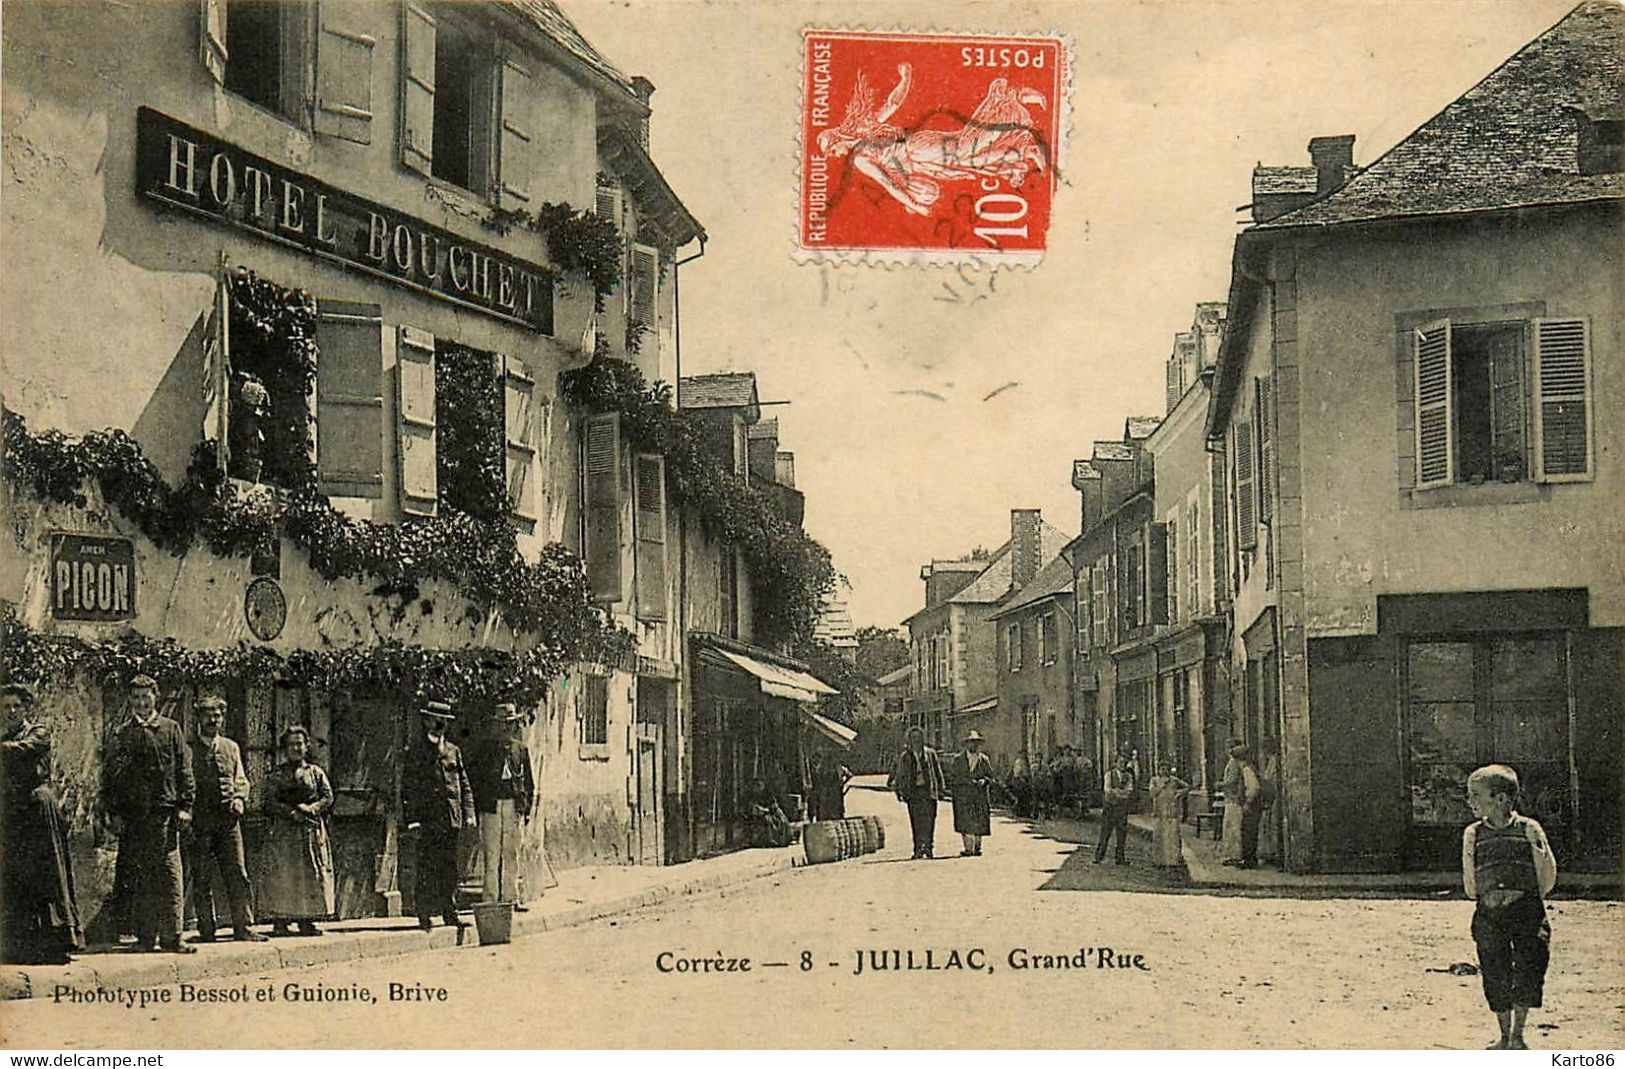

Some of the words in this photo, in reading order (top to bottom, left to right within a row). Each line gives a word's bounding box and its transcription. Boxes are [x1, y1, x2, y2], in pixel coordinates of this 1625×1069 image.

[812, 41, 832, 127] FRANÇAISE
[962, 47, 1045, 68] POSTES
[164, 133, 338, 246] HOTEL
[366, 212, 540, 315] BOUCHET
[809, 153, 828, 242] REPUBLIQUE
[56, 560, 129, 612] PICON
